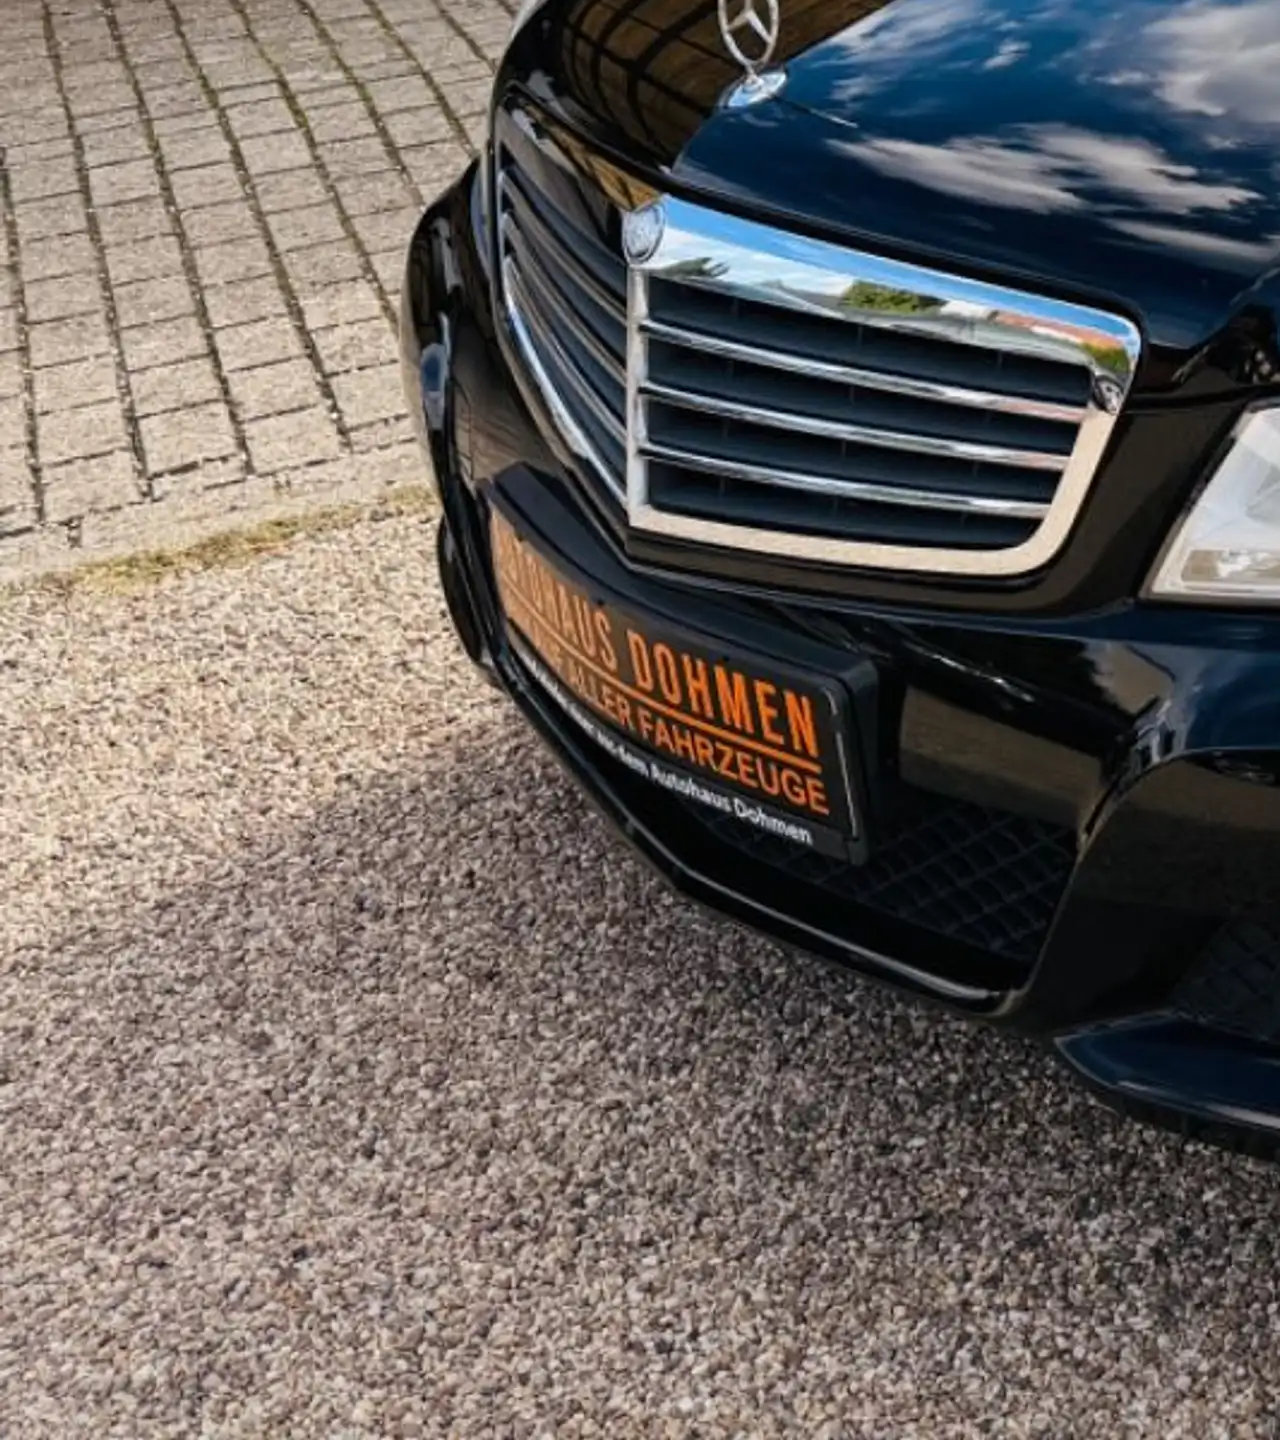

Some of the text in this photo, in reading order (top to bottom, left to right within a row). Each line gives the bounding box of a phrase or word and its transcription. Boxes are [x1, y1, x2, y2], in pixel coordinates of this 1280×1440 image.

[624, 627, 820, 759] DOHMEN
[638, 709, 830, 817] FAHRZEUGE
[650, 762, 814, 846] Autohaus Dohmen
